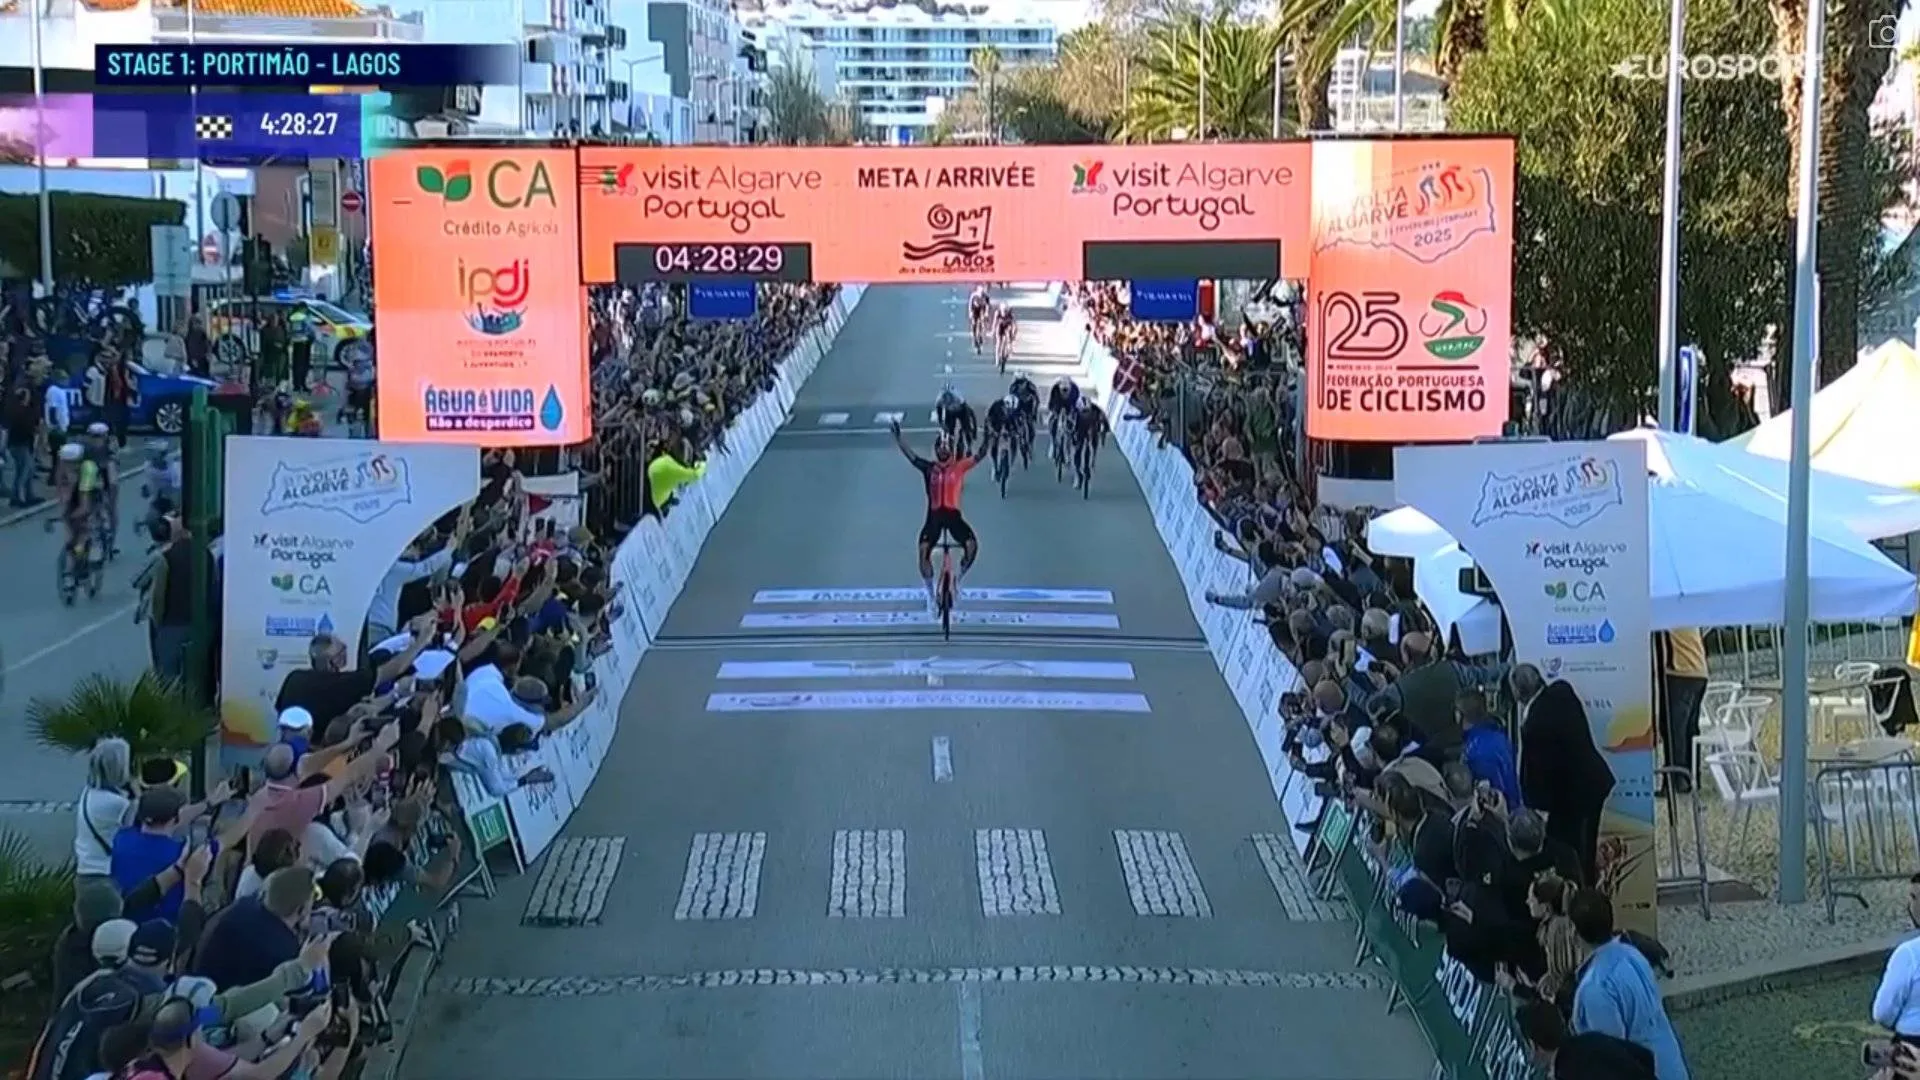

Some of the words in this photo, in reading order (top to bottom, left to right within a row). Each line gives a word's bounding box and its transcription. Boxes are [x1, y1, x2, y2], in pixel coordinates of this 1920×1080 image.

[487, 159, 557, 210] CA
[643, 165, 701, 190] visit
[705, 165, 822, 194] Algarve
[858, 167, 915, 188] META
[924, 167, 932, 188] /
[937, 162, 1036, 188] ARRIVÉE
[1112, 162, 1171, 188] visit
[1177, 162, 1293, 191] Algarve
[643, 195, 786, 235] Portugal
[1113, 192, 1256, 231] Portugal
[443, 219, 501, 236] Crédito
[1413, 228, 1452, 248] 2025
[654, 245, 783, 273] 04:28:29
[458, 257, 529, 308] ipdj
[1326, 373, 1393, 391] FEDERAÇÃO
[1397, 375, 1485, 388] PORTUGUESA
[425, 384, 475, 413] ÁGUA
[490, 388, 535, 413] VIDA
[1327, 389, 1352, 411] DE
[1359, 389, 1486, 412] CICLISMO
[303, 467, 349, 483] VOLTA
[1511, 472, 1559, 492] VOLTA
[282, 478, 350, 501] ALGARVE
[1492, 485, 1559, 510] ALGARVE
[271, 533, 298, 547] visit
[301, 533, 355, 550] Algarve
[1543, 541, 1571, 555] visit
[1573, 541, 1627, 556] Algarve
[271, 548, 337, 569] Portugal
[1543, 556, 1610, 576] Portugal
[298, 573, 332, 596] CA
[1572, 581, 1606, 602] CA
